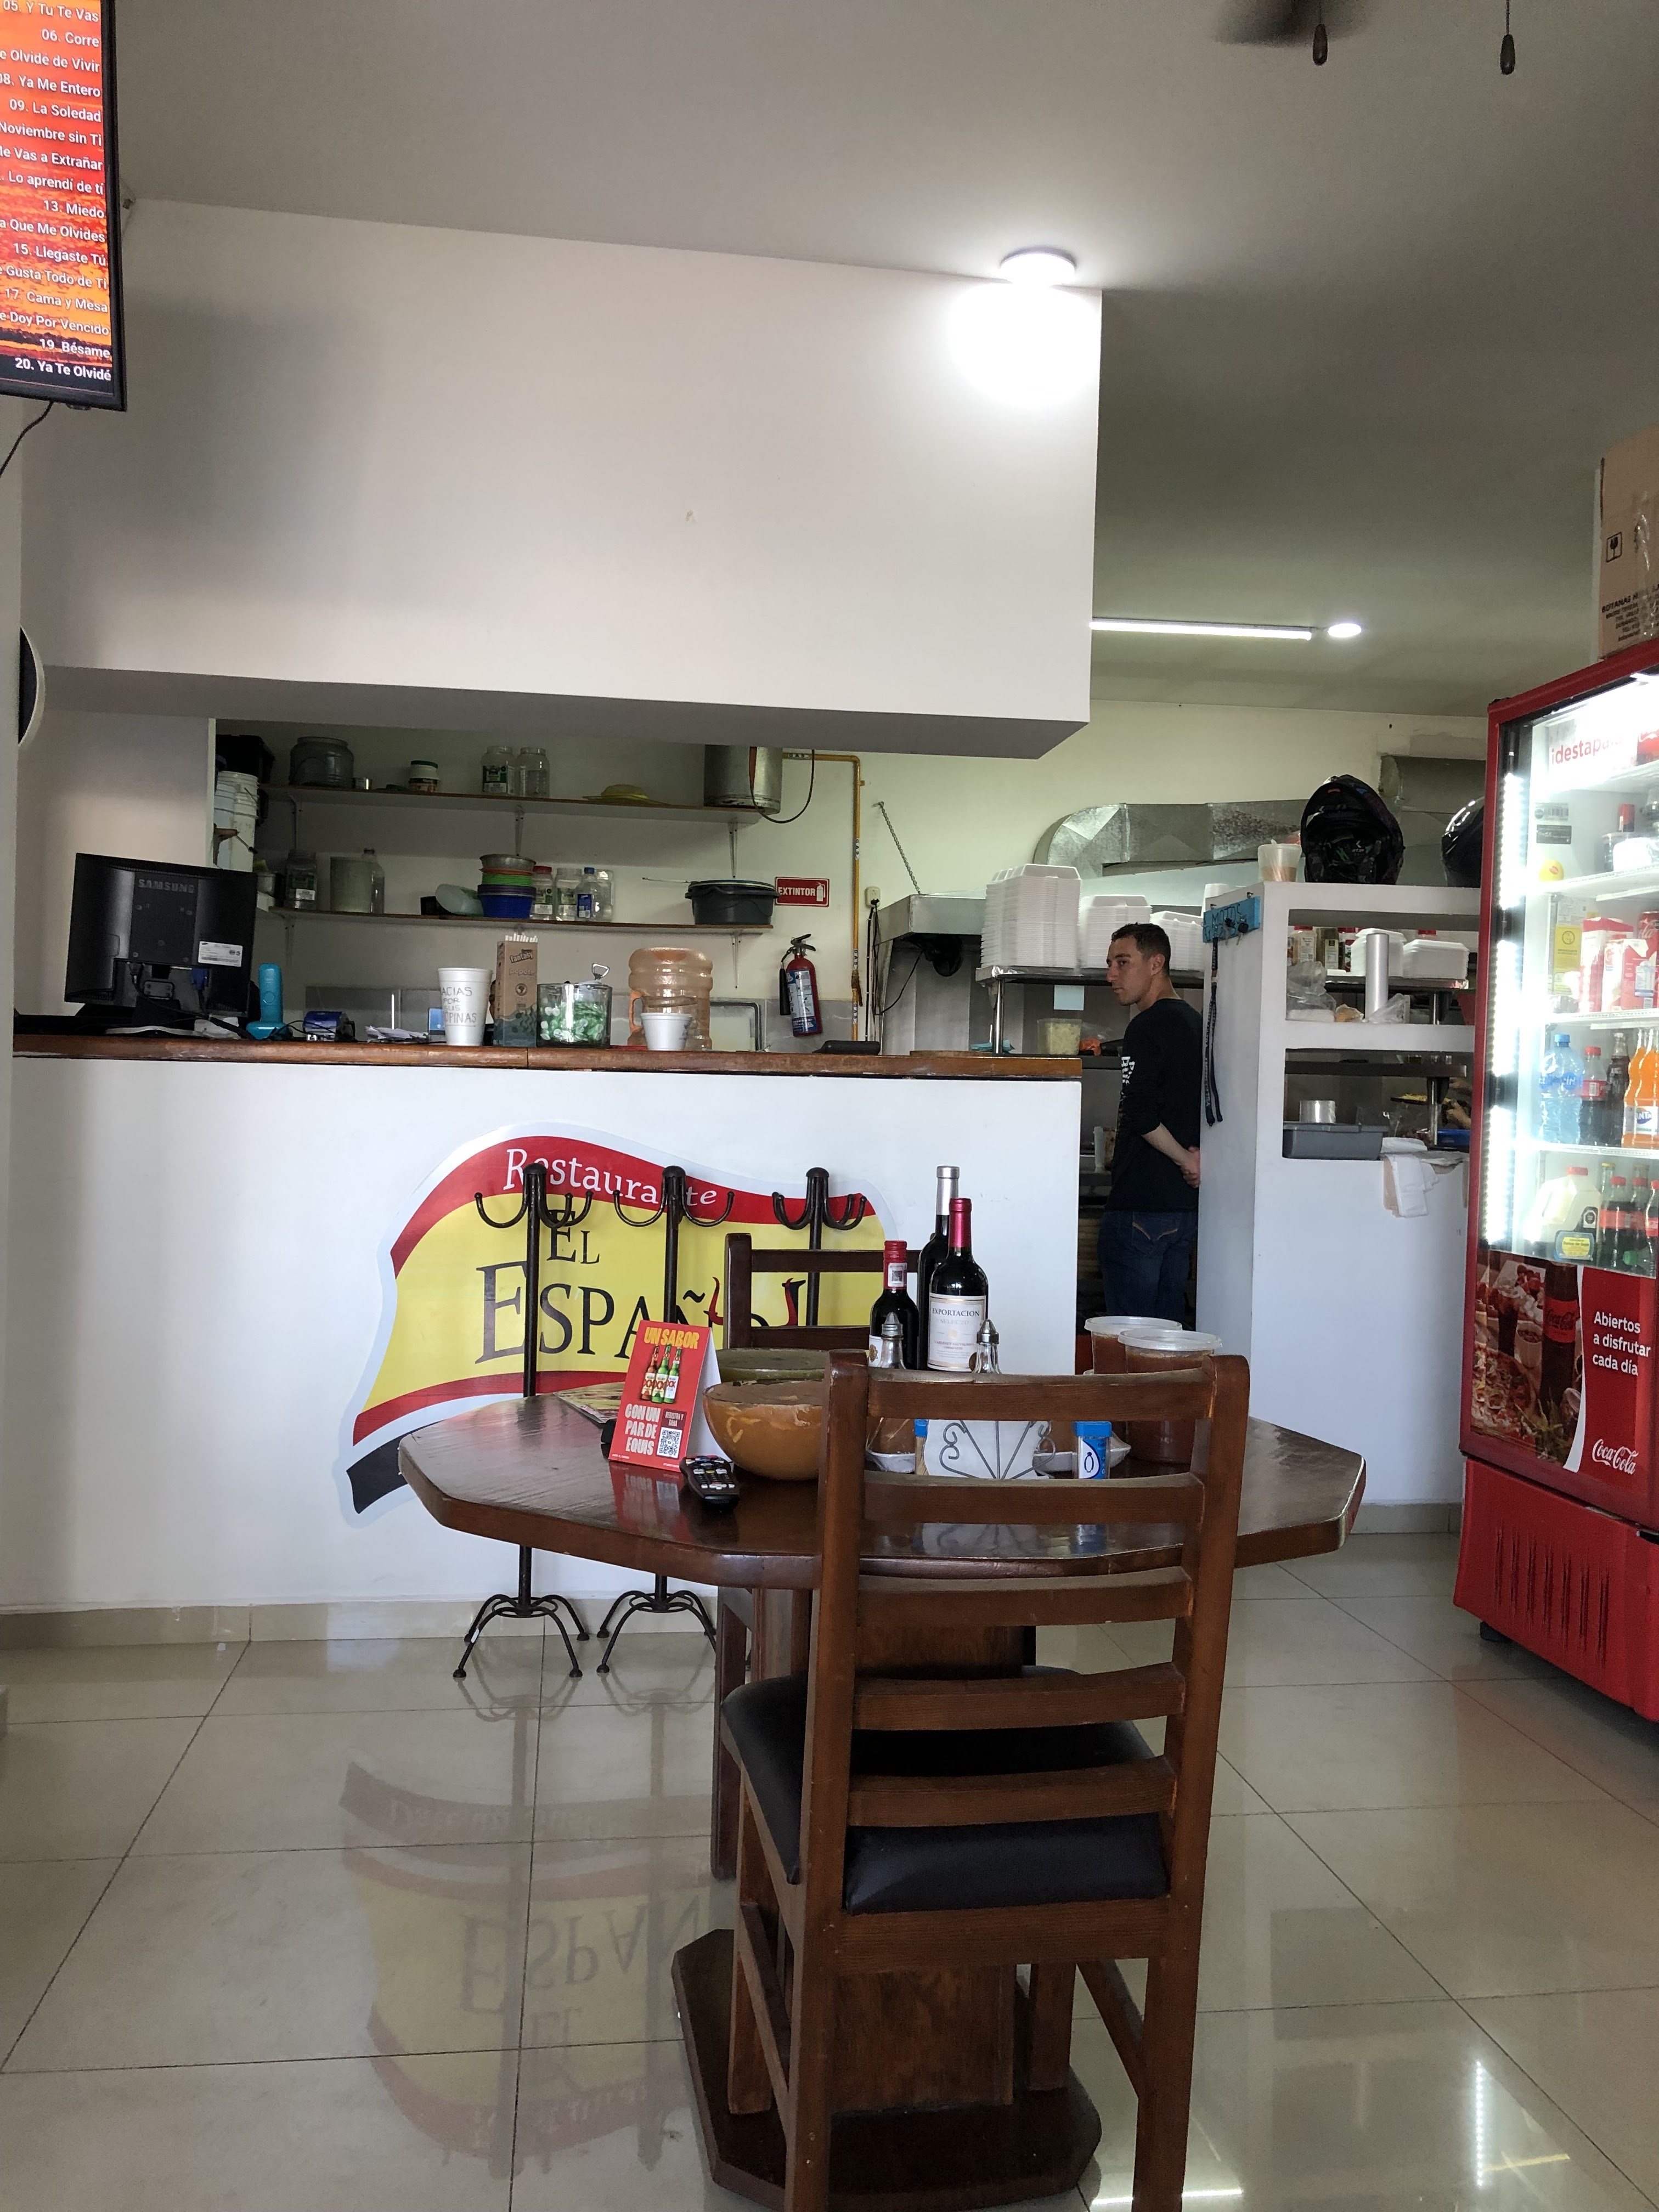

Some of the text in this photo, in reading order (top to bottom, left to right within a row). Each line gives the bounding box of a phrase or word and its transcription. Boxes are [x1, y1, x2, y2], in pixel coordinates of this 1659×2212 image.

[3, 0, 99, 22] 05. Y Tu Te Vas
[42, 29, 99, 47] 06. Corre
[53, 55, 68, 67] de
[71, 57, 100, 72] Vivir
[19, 75, 33, 88] Ya
[37, 77, 57, 91] Me
[60, 81, 100, 97] Entero
[9, 99, 101, 122] 09. La Soledad
[0, 121, 102, 146] Noviembre sin Ti
[14, 148, 37, 161] Vas
[41, 154, 48, 163] a
[52, 153, 103, 171] Extrañar
[9, 171, 24, 183] Lo
[77, 180, 92, 193] de
[44, 200, 104, 218] 13. Miedo
[10, 219, 33, 232] Que
[38, 223, 57, 235] Me
[60, 226, 105, 242] Olvides
[14, 243, 106, 266] 15. Llegaste Tú
[7, 266, 41, 280] Gusta
[45, 270, 74, 284] Todo
[78, 275, 92, 287] de
[96, 278, 107, 290] Ti
[27, 291, 61, 306] Cama
[65, 299, 71, 309] y
[76, 298, 108, 313] Mesa
[10, 312, 32, 326] Doy
[36, 315, 57, 328] Por
[60, 318, 109, 335] Vencido
[62, 341, 110, 358] Bésame
[15, 358, 111, 381] 20. Ya Te Olvidé
[138, 879, 195, 894] SAMSUNG
[778, 887, 816, 896] EXTINTOR
[510, 951, 533, 963] fantasy
[932, 1307, 980, 1317] EXPORTACION
[1594, 1311, 1640, 1334] Abiertos
[644, 1327, 700, 1349] UN SABOR
[1593, 1334, 1651, 1357] a disfrutar
[1593, 1354, 1638, 1376] cada día
[625, 1403, 661, 1423] CON UN
[625, 1420, 658, 1439] PAR DE
[625, 1436, 654, 1455] EQUIS
